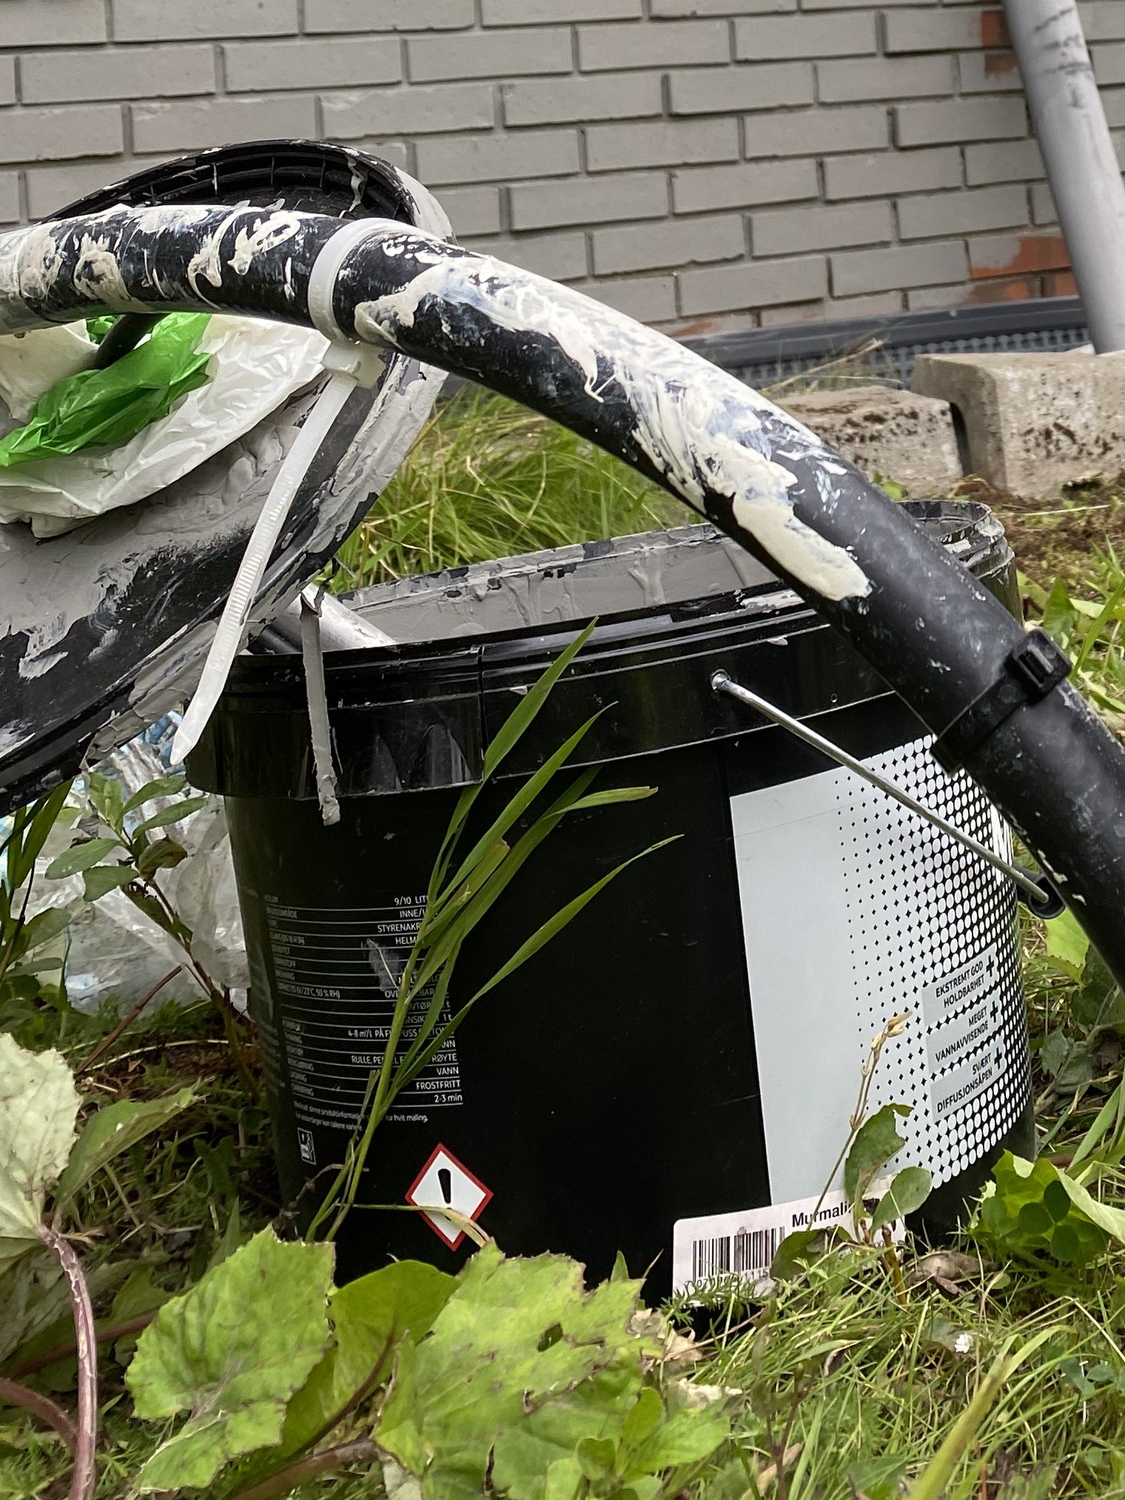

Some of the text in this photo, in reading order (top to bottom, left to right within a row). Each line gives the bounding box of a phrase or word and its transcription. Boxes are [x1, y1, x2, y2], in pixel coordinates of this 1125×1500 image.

[936, 961, 984, 998] EKSTREMT GOD
[944, 974, 985, 1008] HOLDBARHET
[968, 1006, 987, 1027] MEGET
[935, 1020, 988, 1062] VANNAVVISENDE
[436, 1067, 459, 1076] VANN
[972, 1052, 991, 1074] SVÆRT
[416, 1079, 461, 1090] FROSTFRITT
[937, 1066, 992, 1113] DIFFUSJONSÅPEN
[447, 1092, 463, 1102] min
